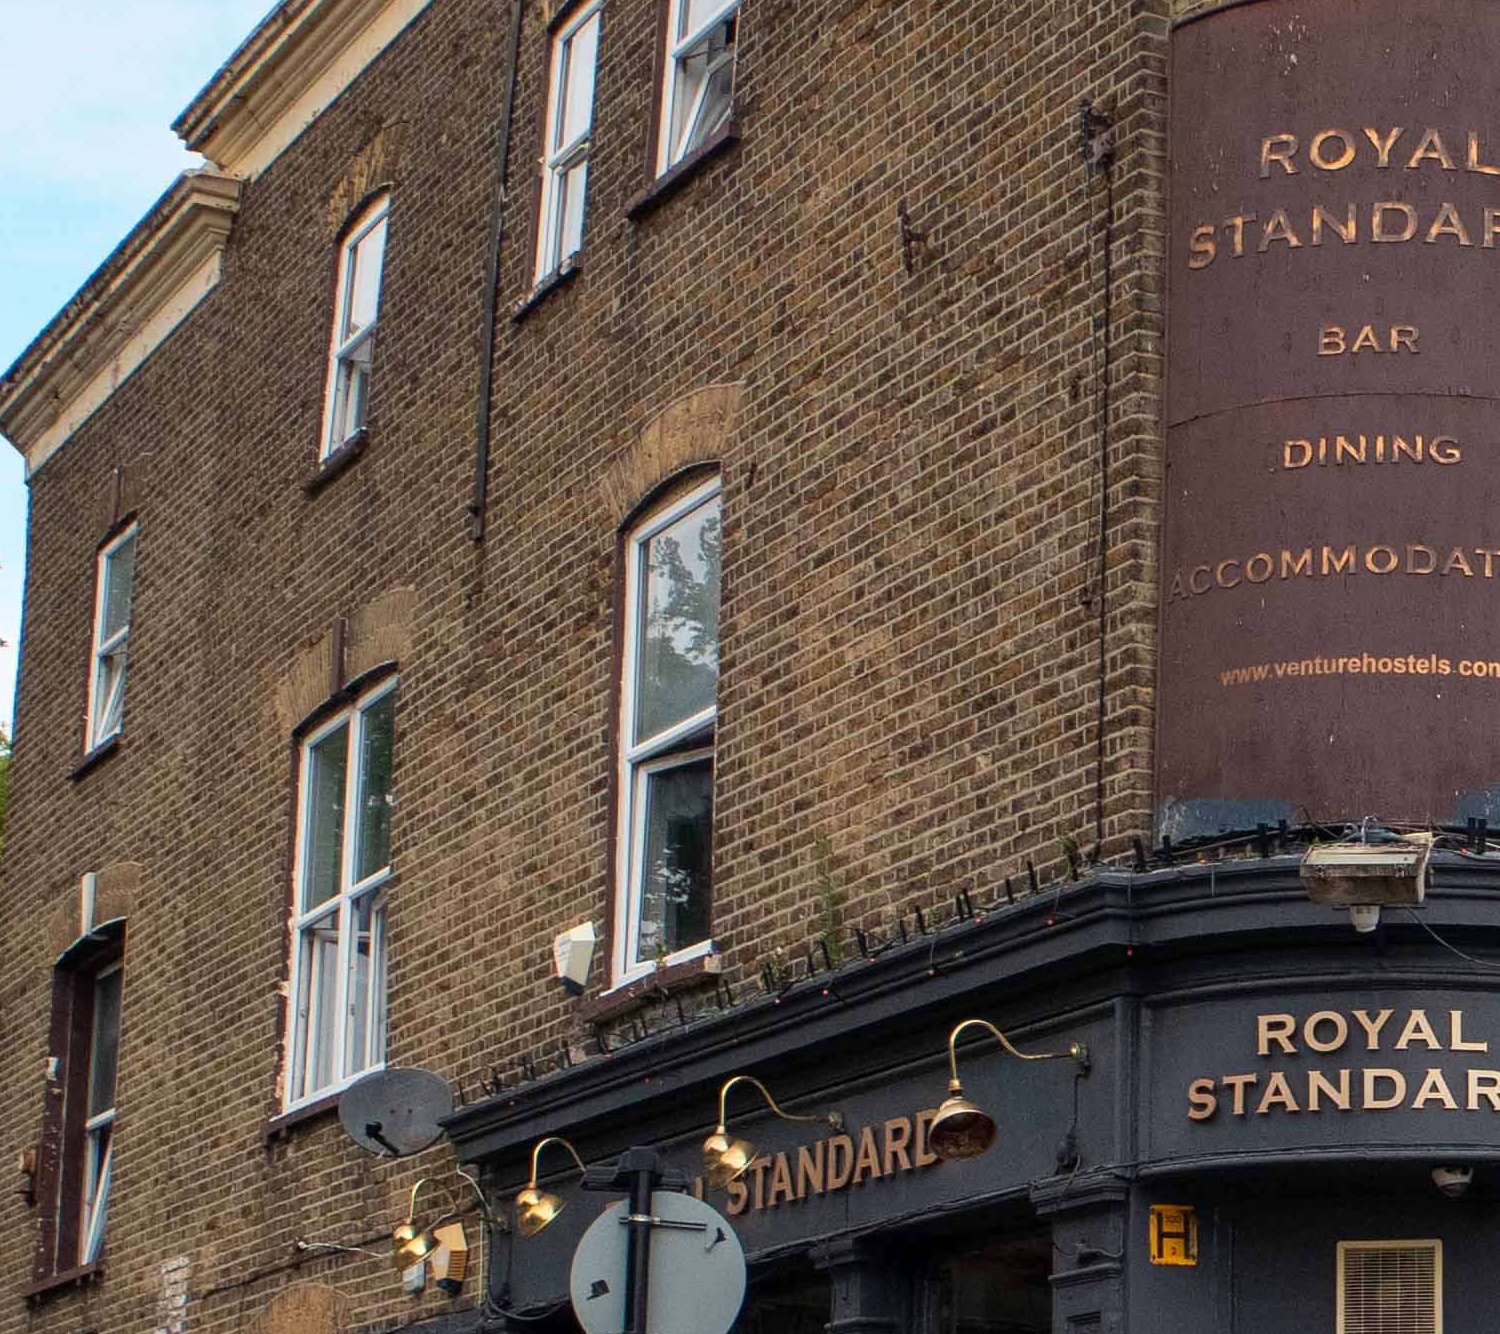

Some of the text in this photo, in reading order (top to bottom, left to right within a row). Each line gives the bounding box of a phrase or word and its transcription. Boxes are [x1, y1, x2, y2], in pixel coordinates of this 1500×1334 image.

[1317, 324, 1421, 356] BAR
[1282, 433, 1462, 470] DINING
[1256, 1008, 1489, 1057] ROYAL
